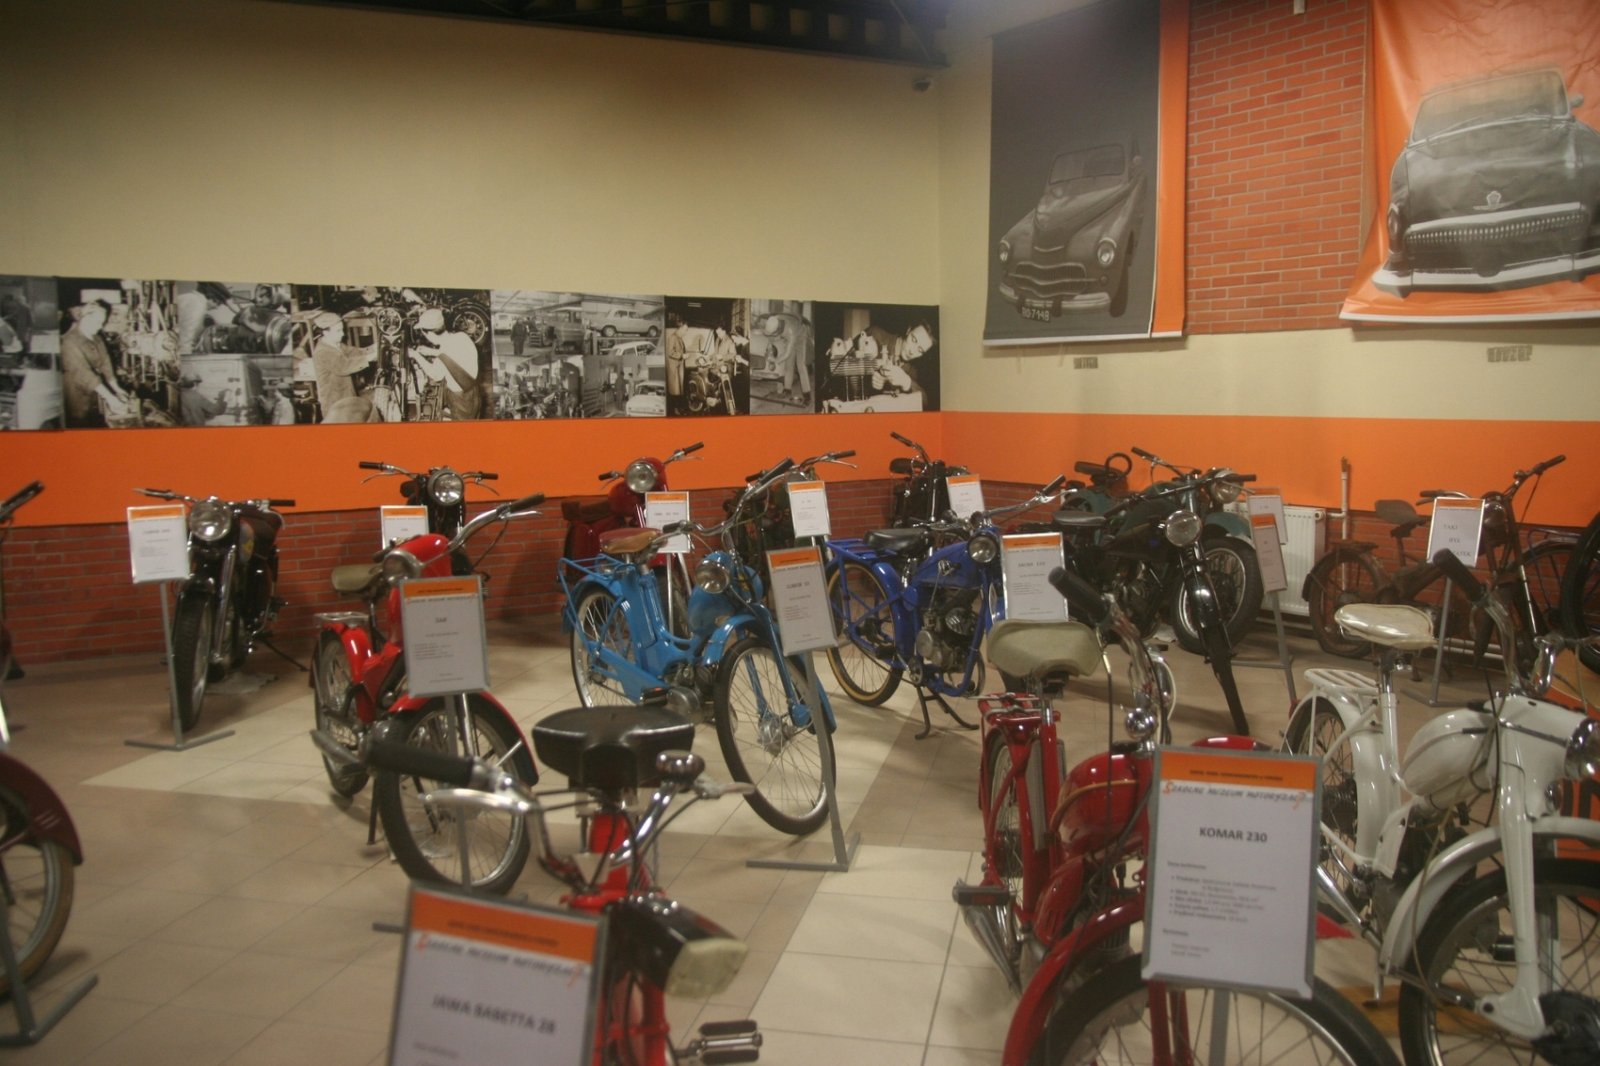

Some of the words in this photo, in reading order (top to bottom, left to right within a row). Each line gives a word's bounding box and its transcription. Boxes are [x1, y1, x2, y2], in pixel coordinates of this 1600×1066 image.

[1208, 785, 1244, 797] MUZEUM
[1199, 827, 1244, 841] KOMAR
[1246, 831, 1268, 843] 230
